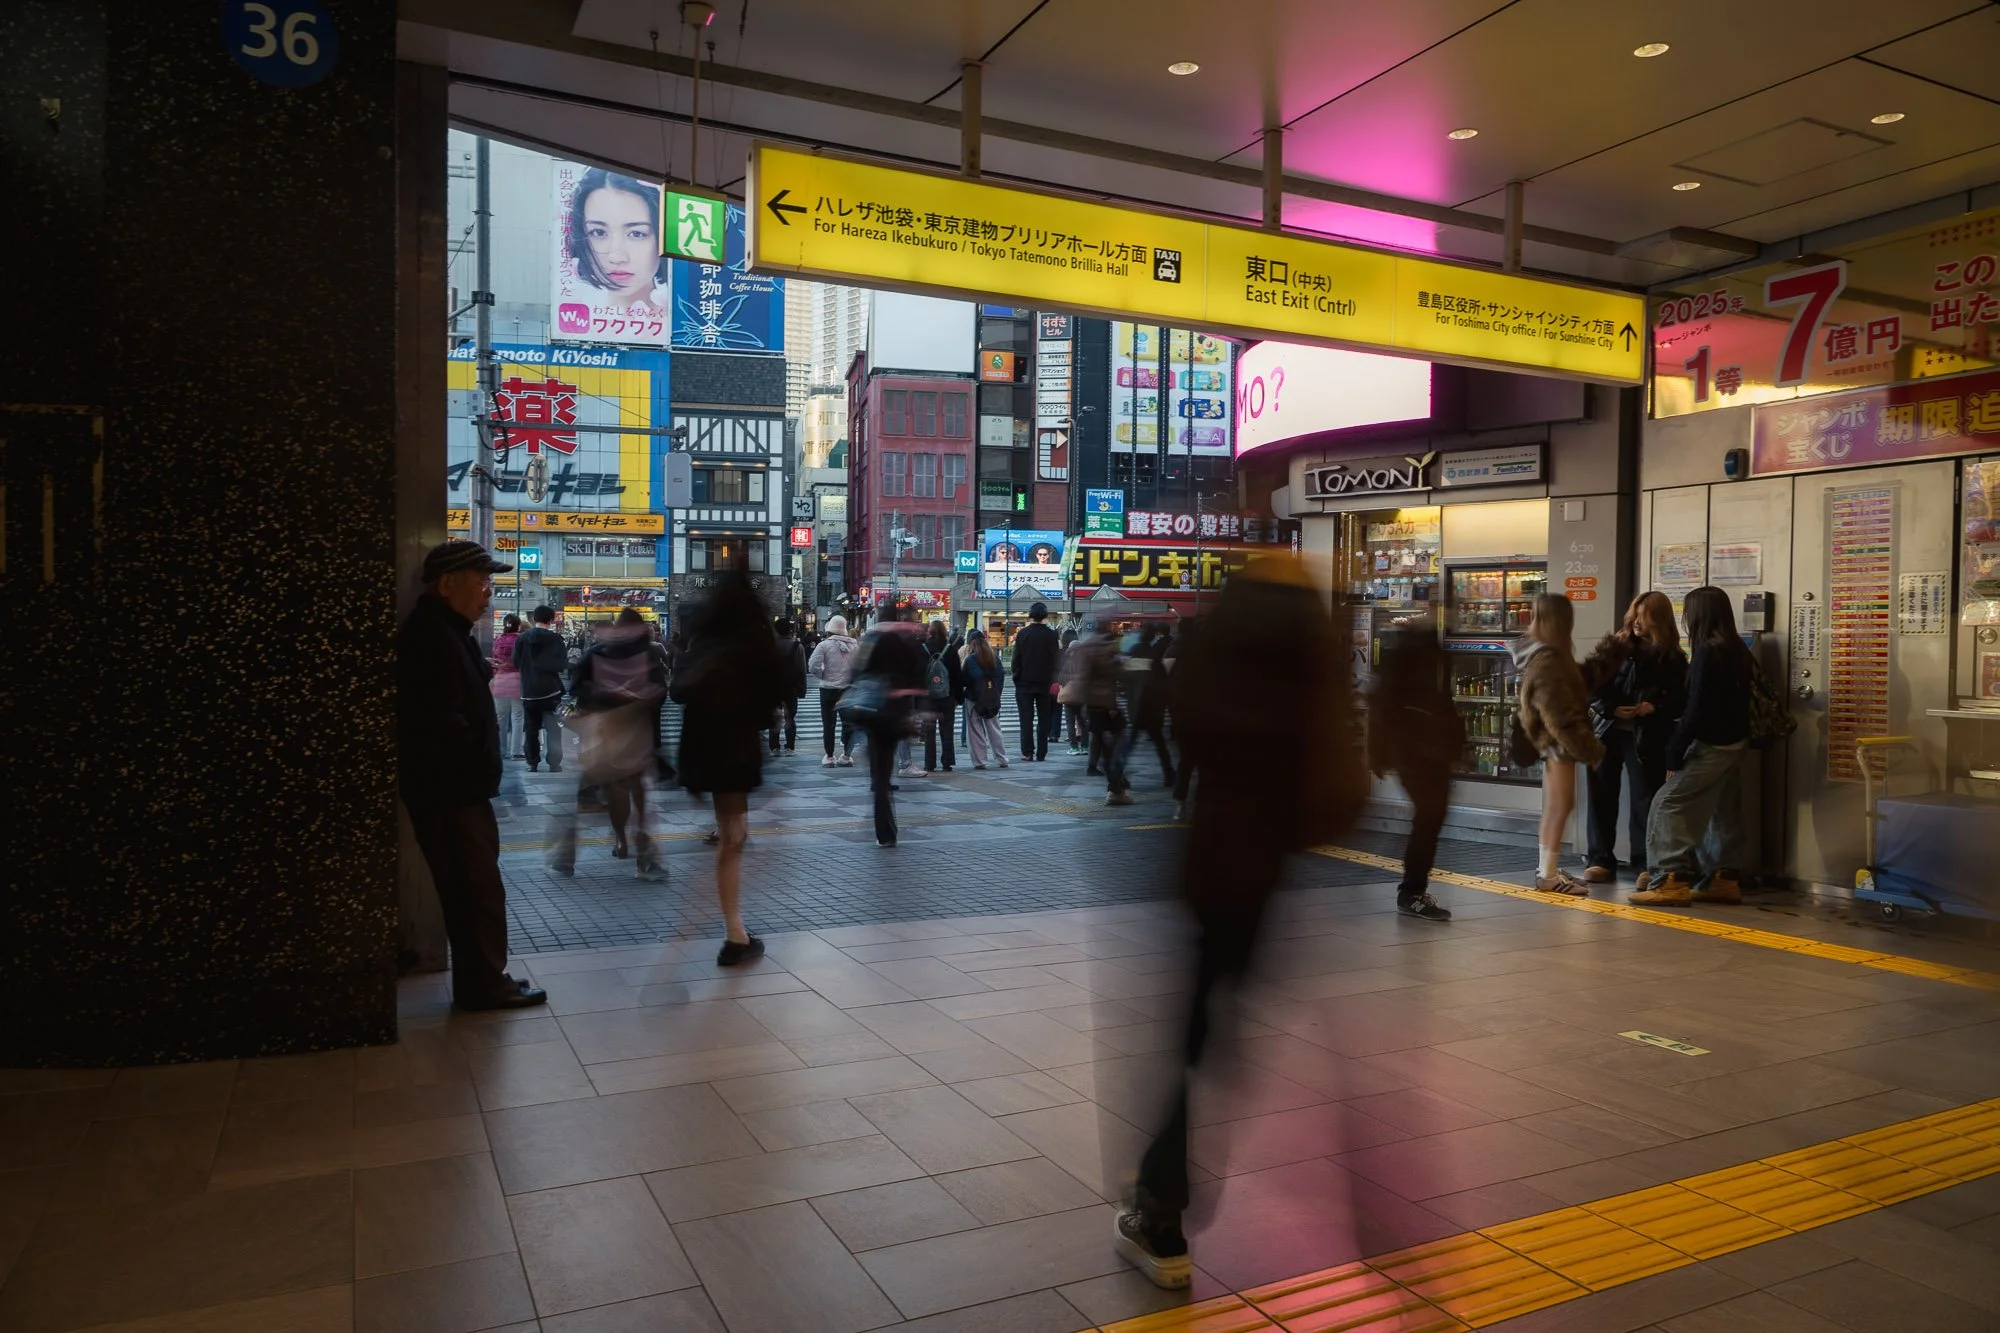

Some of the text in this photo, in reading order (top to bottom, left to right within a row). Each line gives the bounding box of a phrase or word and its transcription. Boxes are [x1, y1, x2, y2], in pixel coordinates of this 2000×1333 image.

[242, 3, 319, 65] 36
[814, 196, 1147, 264] ハレザ池袋・東京建物ブリリアホール方面
[814, 218, 836, 233] For
[841, 222, 887, 241] Hareza
[892, 229, 957, 251] Ikebukuro
[971, 242, 1006, 261] Tokyo
[1010, 248, 1067, 268] Tatemono
[1071, 257, 1102, 273] Brillia
[1107, 262, 1128, 276] Hall
[1155, 250, 1179, 261] TAXI
[733, 272, 774, 282] Traditional
[1934, 255, 1996, 292] この
[729, 282, 774, 293] Coffee House
[1246, 285, 1356, 316] East Exit (Cntrl)
[593, 304, 665, 319] わたしをひらく
[1417, 291, 1614, 336] 豊島区役所・サンシャインシティ方面
[1659, 290, 1744, 329] 2025年
[1931, 292, 2000, 332] 出た
[592, 318, 663, 337] ワクワク
[1042, 316, 1067, 328] すずき
[1046, 328, 1063, 336] ビル
[1436, 312, 1450, 325] For
[1454, 315, 1490, 331] Toshima
[1492, 320, 1509, 336] City
[1512, 324, 1536, 338] office
[1544, 328, 1558, 341] For
[1560, 331, 1596, 346] Sunshine
[1598, 336, 1614, 351] City
[552, 349, 618, 366] KiYoshi
[1685, 347, 1742, 403] 1等
[490, 376, 579, 455] 薬
[1778, 401, 1868, 436] ジャンボ
[1787, 433, 1852, 463] 宝くじ
[1304, 451, 1436, 493] TOMONY
[1497, 465, 1532, 473] FamilyMart
[1100, 491, 1121, 500] Wi-Fi
[546, 514, 627, 528] 薬 マツモトキヨシ
[1088, 516, 1100, 528] 薬
[1128, 512, 1239, 537] 驚安の殿堂
[496, 537, 526, 550] Shop
[1570, 541, 1593, 553] 6:30
[1565, 562, 1598, 573] 23:00
[1012, 575, 1055, 583] メガネスーパー
[1569, 578, 1592, 587] たばこ
[1572, 591, 1588, 600] お酒
